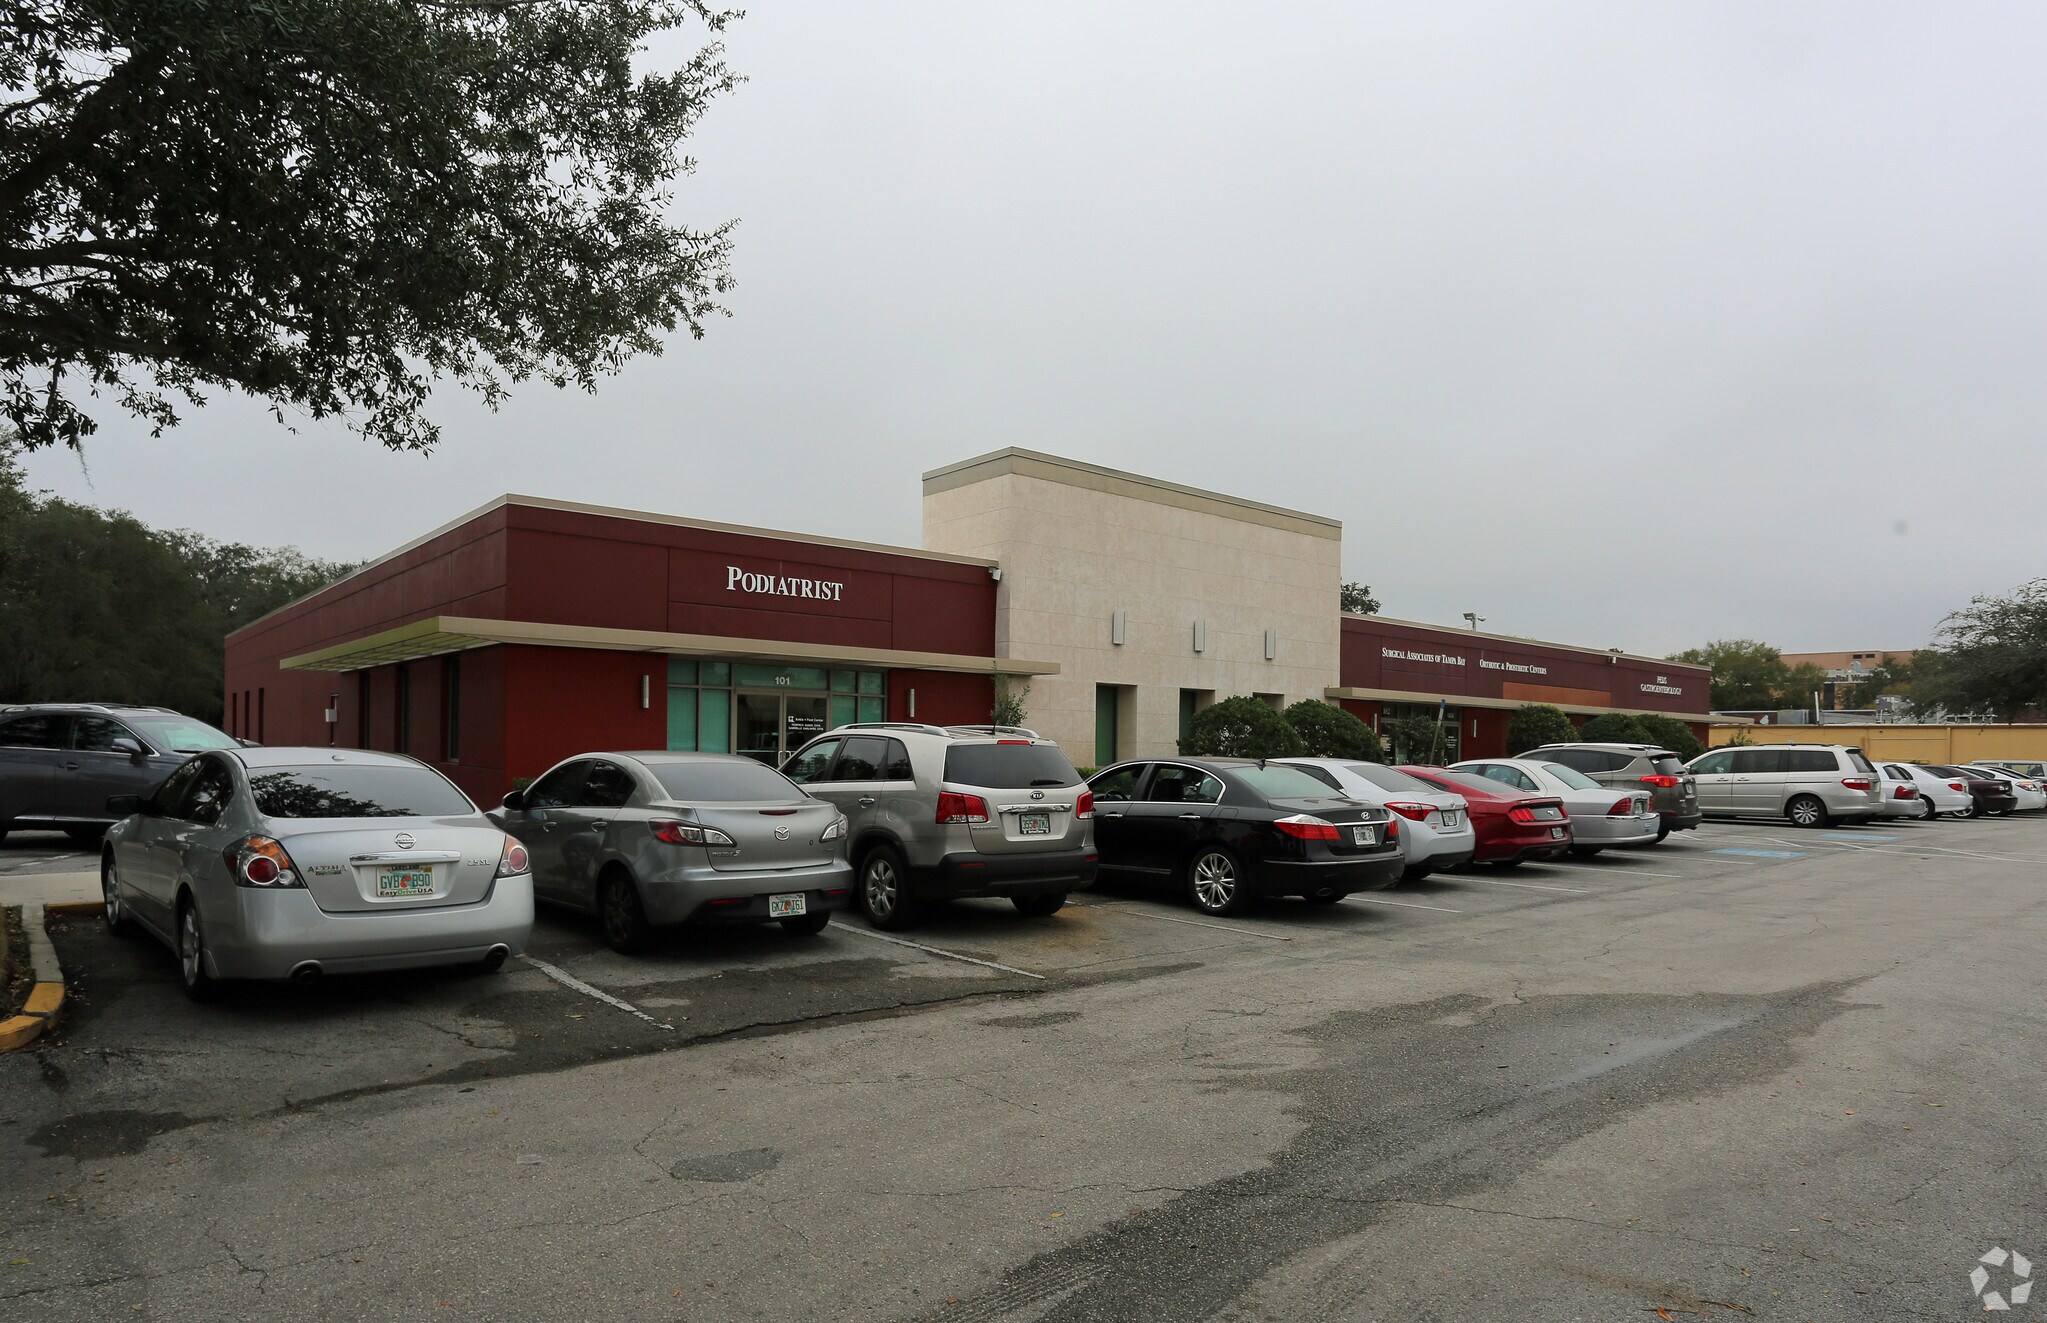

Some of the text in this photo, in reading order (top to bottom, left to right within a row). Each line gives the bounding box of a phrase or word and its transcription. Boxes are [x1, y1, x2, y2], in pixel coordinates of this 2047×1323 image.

[726, 565, 843, 601] PODIATRIST
[1382, 647, 1405, 659] SURGICAL
[1406, 650, 1434, 662] ASSOCIATES
[1441, 654, 1456, 665] TAMPA
[1457, 656, 1466, 666] BAY
[775, 676, 790, 685] 101
[307, 864, 348, 873] ALTIMA
[412, 873, 431, 887] B90
